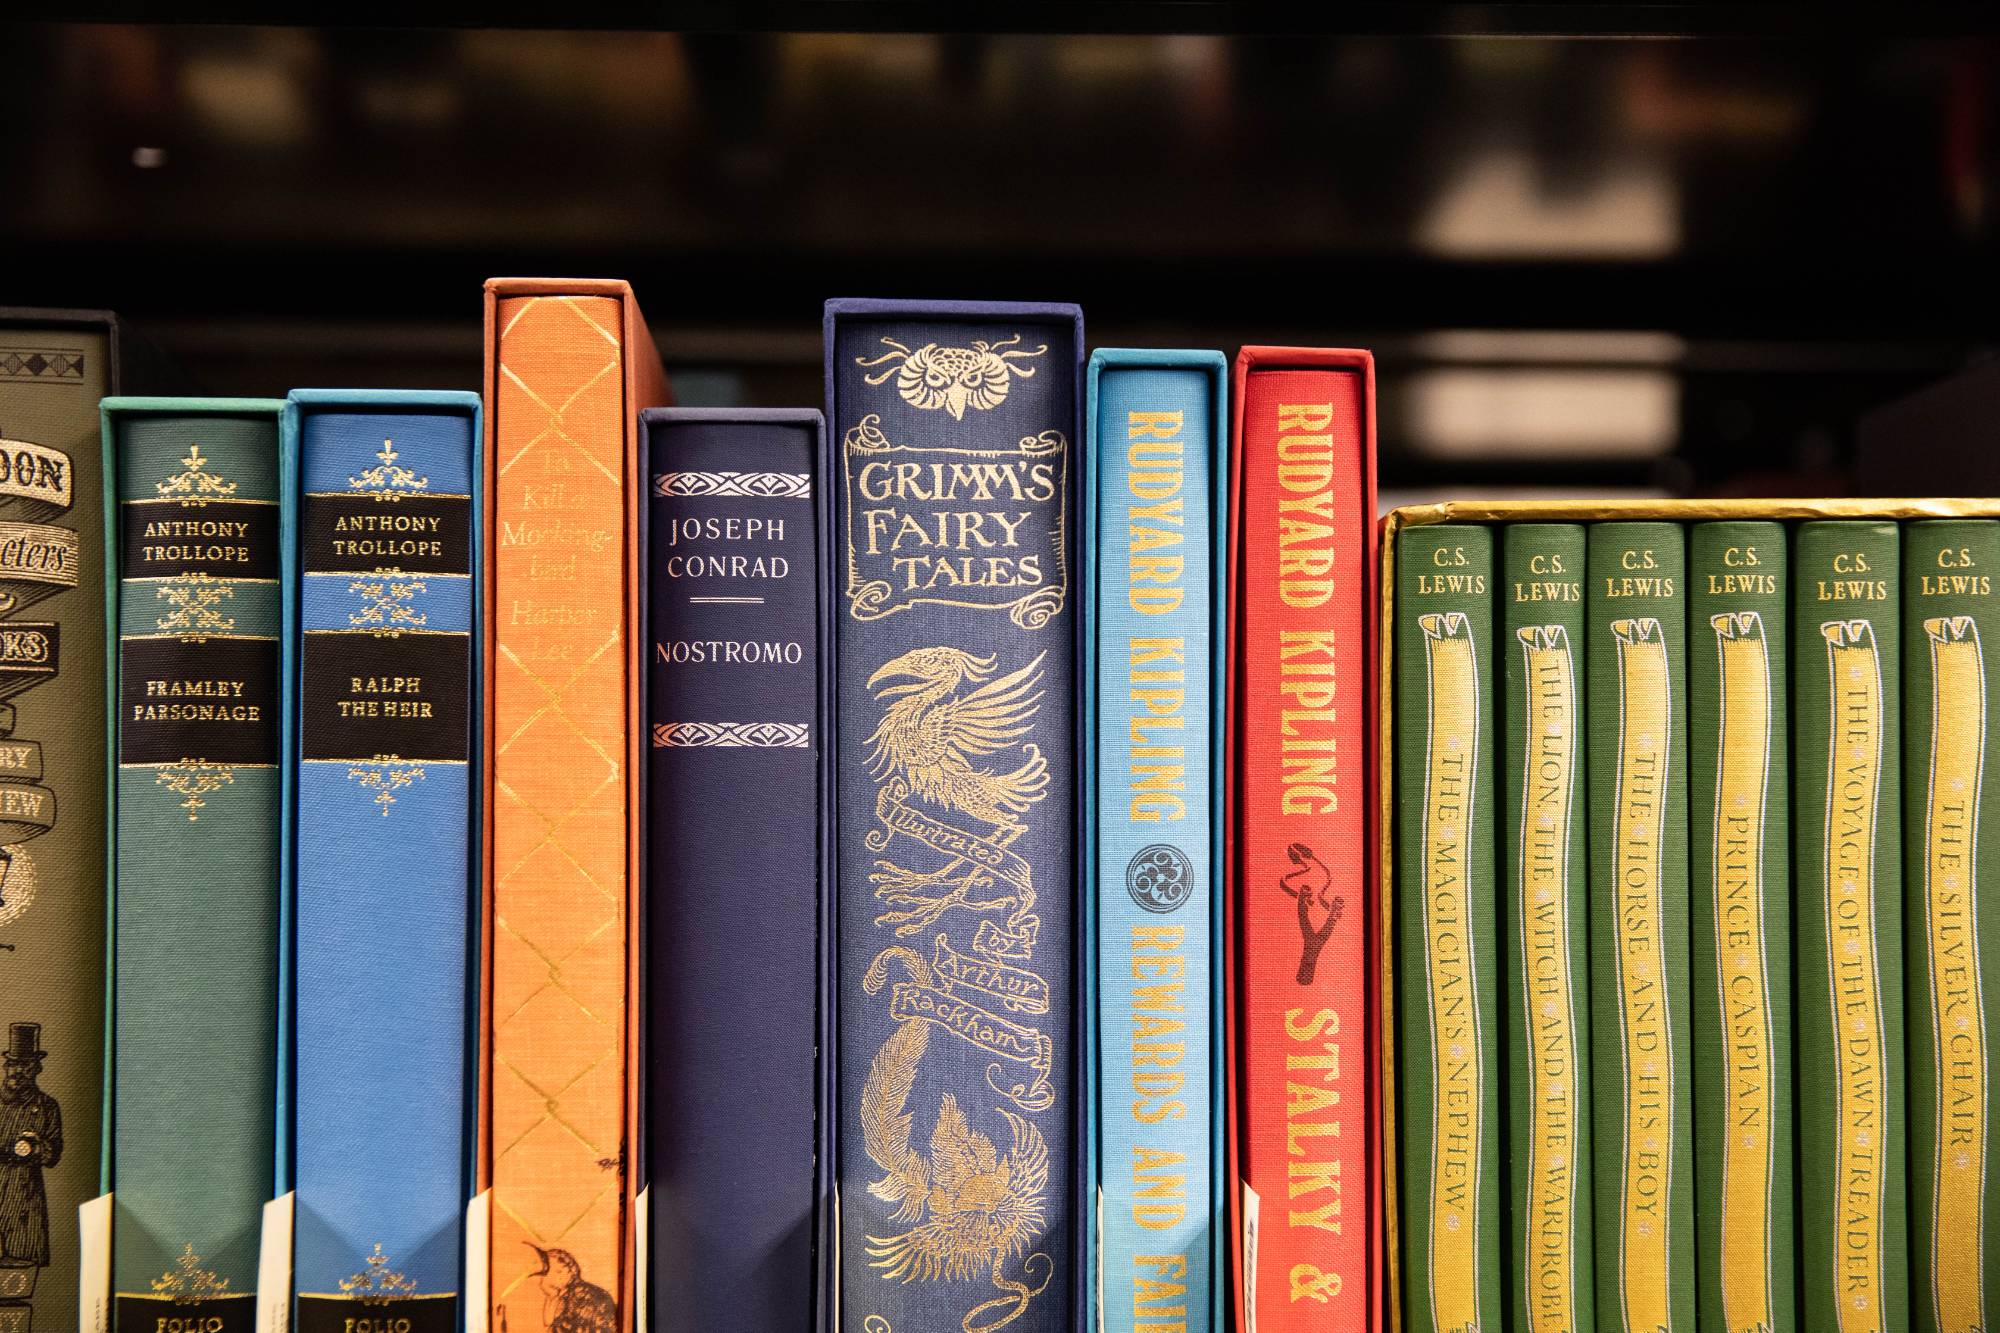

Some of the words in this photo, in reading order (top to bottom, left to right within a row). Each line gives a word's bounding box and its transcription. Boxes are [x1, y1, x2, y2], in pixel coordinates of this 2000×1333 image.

[859, 460, 1055, 502] GRIMM'S
[1277, 402, 1334, 609] RUDYARD
[144, 521, 249, 538] ANTHONY
[335, 516, 441, 533] ANTHONY
[669, 518, 785, 546] JOSEPH
[863, 507, 1032, 555] FAIRY
[1127, 410, 1184, 615] RUDYARD
[143, 545, 249, 562] TROLLOPE
[334, 540, 442, 557] TROLLOPE
[667, 556, 789, 578] CONRAD
[892, 554, 1043, 592] TALES
[1434, 547, 1470, 567] C.S.
[1530, 555, 1567, 574] C.S.
[1622, 550, 1659, 570] C.S.
[1724, 547, 1761, 567] C.S.
[1833, 554, 1872, 573] C.S.
[1937, 548, 1976, 568] C.S.
[1418, 575, 1485, 594] LEWIS
[1514, 583, 1581, 602] LEWIS
[1606, 578, 1674, 597] LEWIS
[1708, 575, 1776, 594] LEWIS
[1817, 581, 1887, 601] LEWIS
[1921, 576, 1991, 595] LEWIS
[656, 640, 803, 664] NOSTROMO
[133, 704, 261, 722] PARSONAGE
[146, 680, 245, 697] FRAMLEY
[337, 701, 379, 718] THE
[383, 702, 434, 719] HEIR
[351, 677, 421, 694] RALPH
[1540, 659, 1564, 718] THE
[1129, 637, 1187, 823] KIPLING
[1280, 629, 1338, 816] KIPLING
[1847, 685, 1870, 744] THE
[1438, 754, 1464, 821] THE
[1629, 753, 1657, 819] THE
[1838, 763, 1868, 879] VOYAGE
[1938, 800, 1966, 870] THE
[1533, 824, 1556, 881] THE
[1624, 840, 1651, 955] HORSE
[1725, 815, 1750, 948] PRINCE
[1434, 841, 1468, 1041] MAGICIAN'S
[1837, 899, 1860, 937] OF
[941, 952, 1040, 996] Arthur
[1534, 901, 1559, 996] WITCH
[1938, 892, 1970, 1017] SILVER
[1840, 955, 1869, 1016] THE
[901, 989, 1034, 1054] Rackham
[1131, 924, 1187, 1124] REWARDS
[1631, 975, 1659, 1052] AND
[1541, 1015, 1566, 1077] AND
[1731, 975, 1761, 1128] CASPIAN
[1638, 1074, 1662, 1129] HIS
[1849, 1035, 1875, 1128] DAWN
[1949, 1032, 1975, 1147] CHAIR
[1285, 1008, 1342, 1236] STALKY
[1445, 1061, 1470, 1211] NEPHEW
[1545, 1090, 1568, 1149] THE
[1131, 1146, 1186, 1232] AND
[1635, 1150, 1661, 1217] BOY
[1540, 1165, 1566, 1327] WARDROBE
[1846, 1148, 1874, 1292] TREADER
[1289, 1263, 1343, 1304] &
[156, 1317, 224, 1333] FOLIO
[345, 1318, 411, 1333] FOLIO
